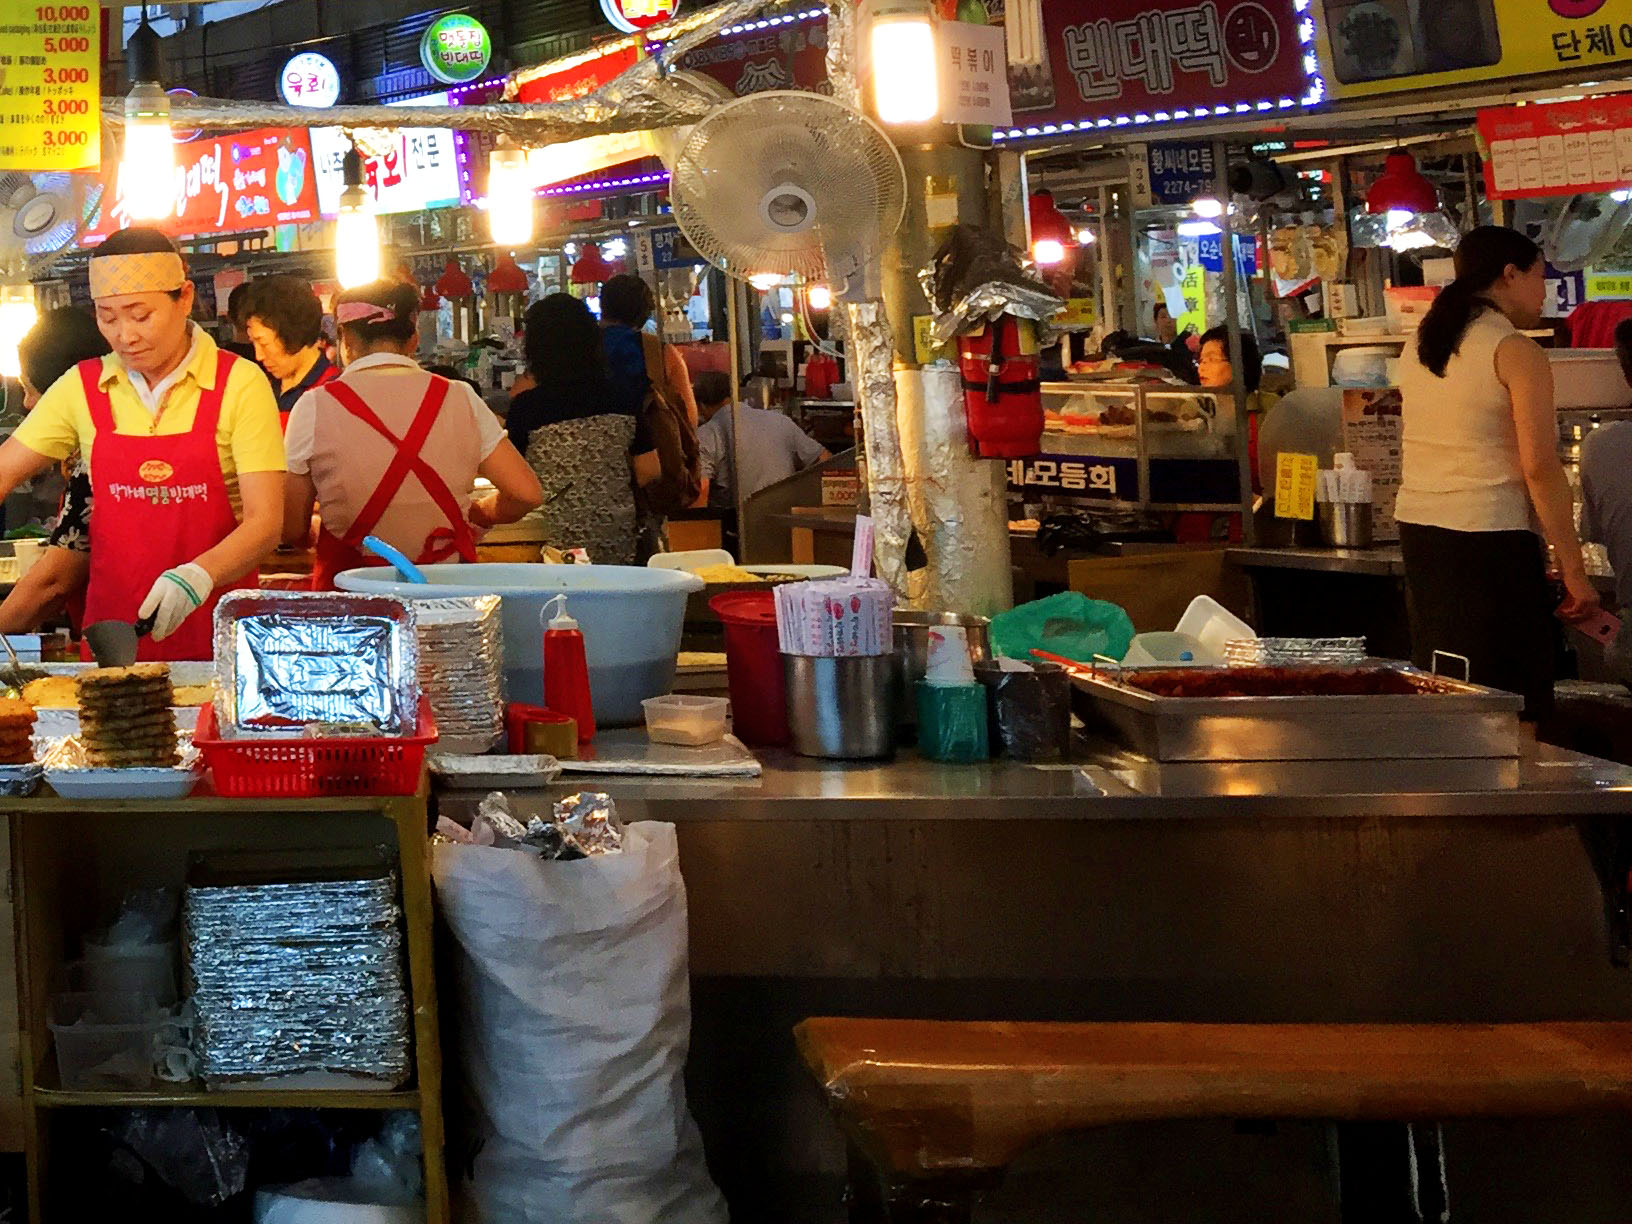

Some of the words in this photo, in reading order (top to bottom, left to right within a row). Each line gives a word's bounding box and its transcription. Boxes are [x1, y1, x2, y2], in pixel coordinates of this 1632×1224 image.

[35, 5, 90, 22] 10,000
[43, 37, 89, 53] 5,000
[1062, 0, 1228, 103] 빈대떡
[43, 67, 89, 84] 3,000
[286, 72, 326, 98] 육회
[43, 99, 89, 115] 3,000
[43, 130, 88, 146] 3,000
[411, 134, 440, 170] 전문
